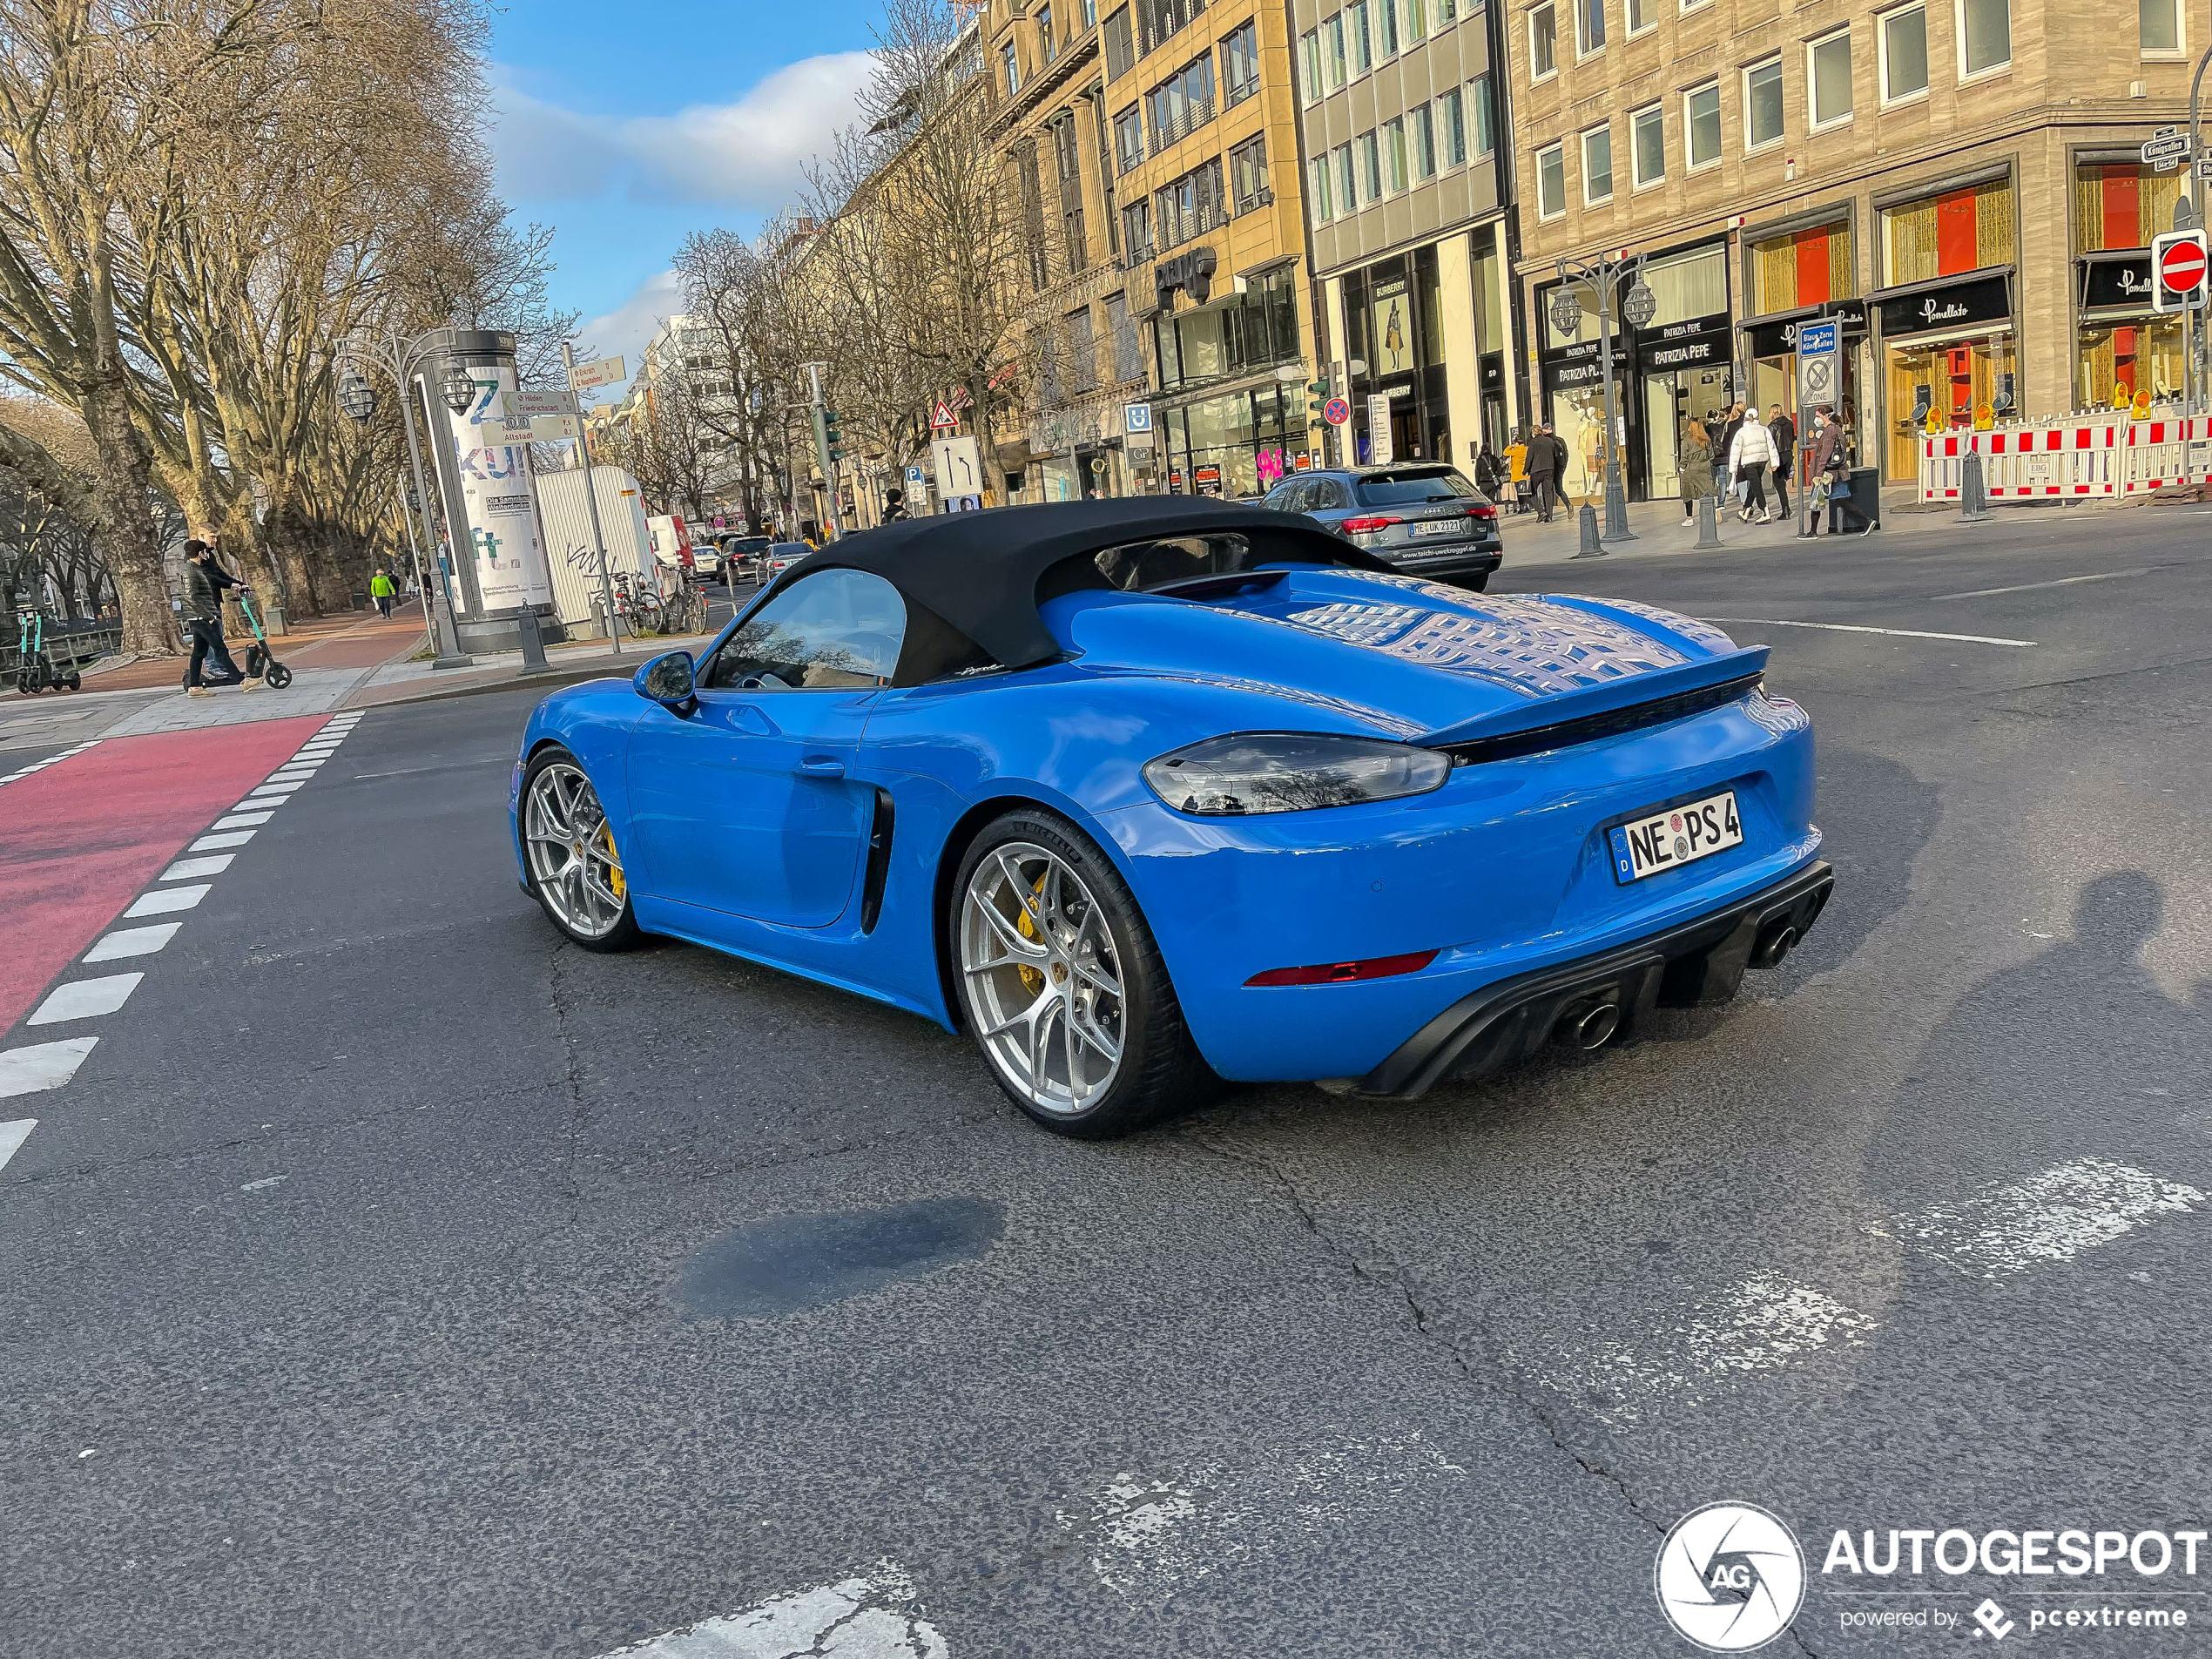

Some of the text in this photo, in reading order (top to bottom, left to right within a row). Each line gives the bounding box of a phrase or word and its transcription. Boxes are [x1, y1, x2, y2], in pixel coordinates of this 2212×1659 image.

[2148, 141, 2183, 157] Königsallee
[1376, 280, 1406, 297] BURBERRY
[1919, 299, 1968, 324] Pomellato
[1663, 323, 1702, 338] PATRIZIA PEPE
[1819, 330, 1833, 340] Zone
[1567, 343, 1598, 357] PATRIZIA PEPE
[1656, 343, 1710, 365] PATRIZIA PEPE
[1559, 367, 1588, 382] PATRIZIA
[504, 432, 534, 441] Altstadt
[1257, 448, 1283, 480] SALE
[908, 469, 918, 481] P
[1414, 521, 1460, 534] ME UK 2121
[1629, 798, 1739, 870] NE PS 4
[1620, 860, 1629, 872] D
